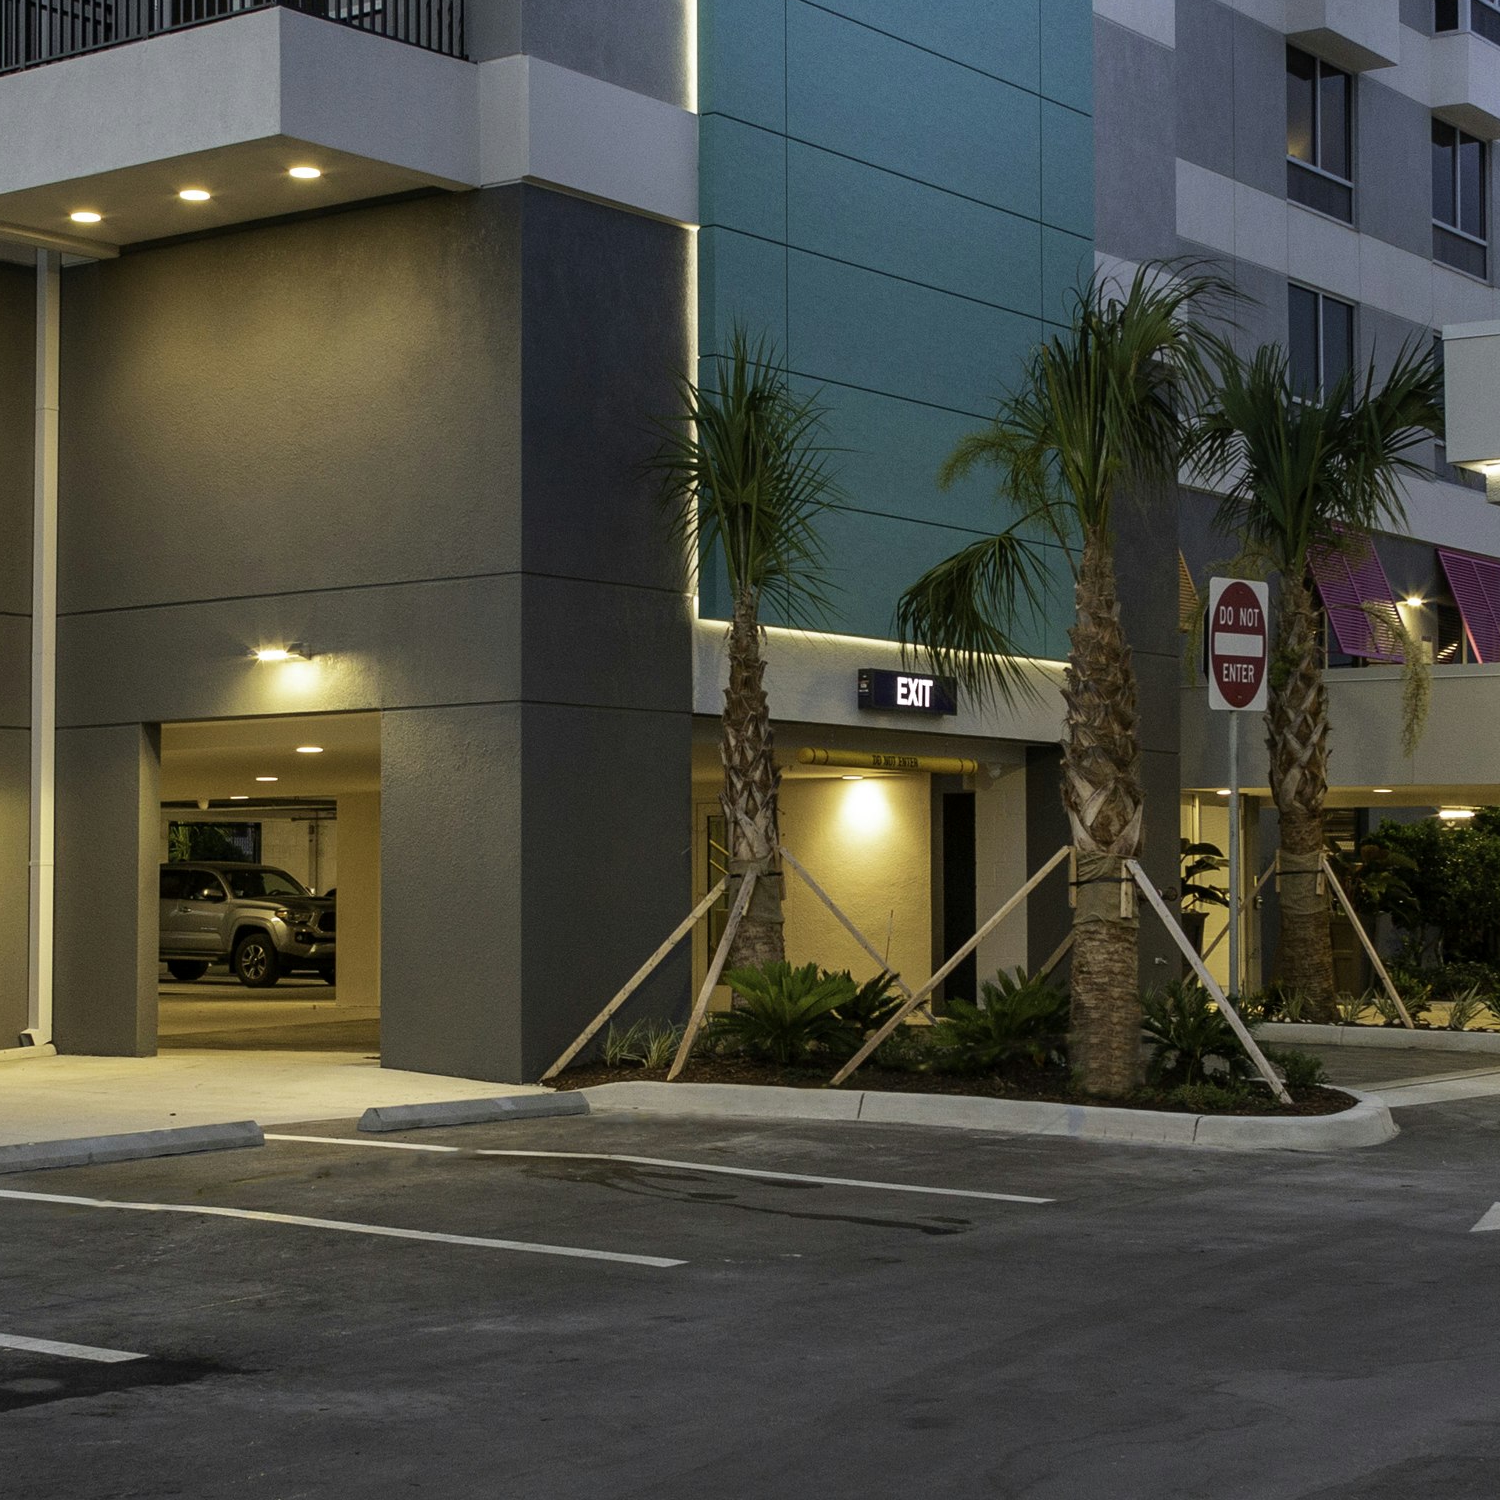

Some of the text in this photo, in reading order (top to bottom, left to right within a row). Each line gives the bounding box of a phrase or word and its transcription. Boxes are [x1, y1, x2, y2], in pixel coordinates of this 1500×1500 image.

[1219, 605, 1260, 628] DO NOT
[1222, 663, 1255, 684] ENTER
[896, 676, 934, 708] EXIT
[872, 755, 918, 768] DO NOT ENTER
